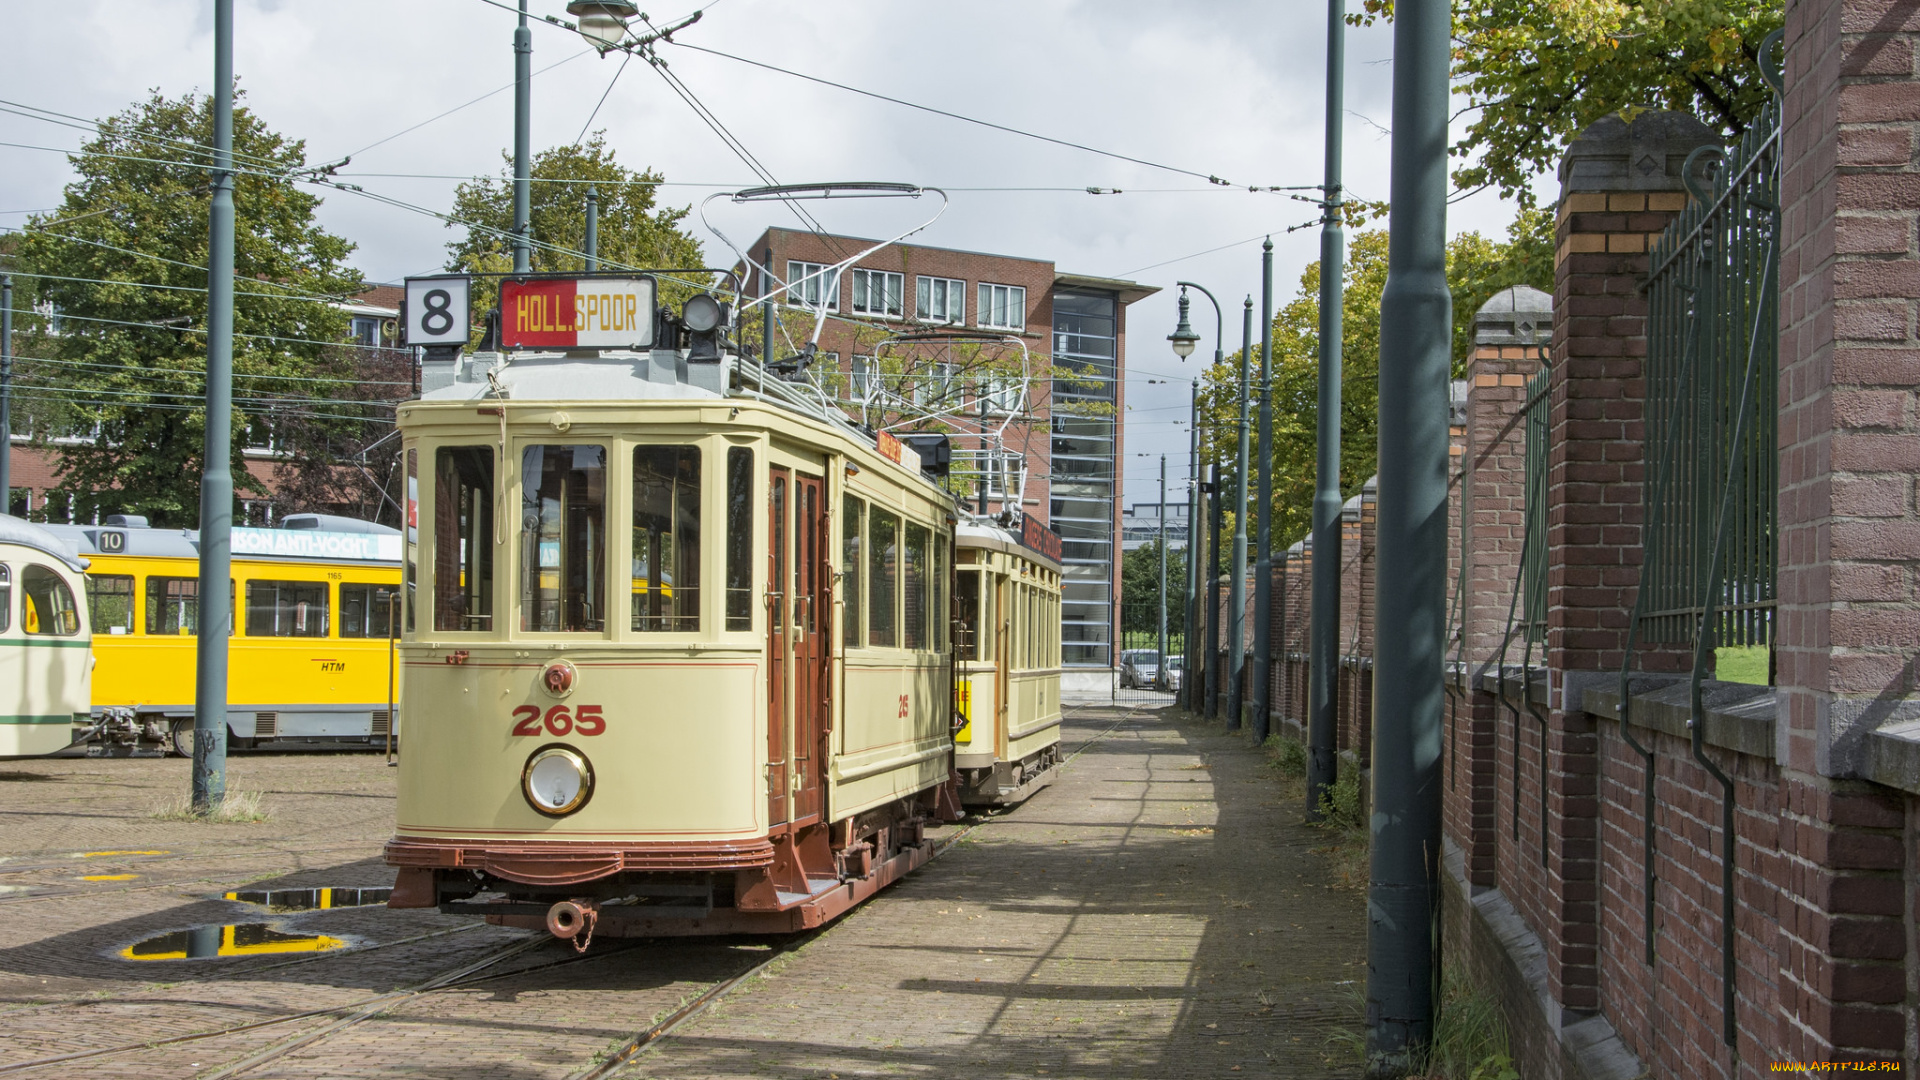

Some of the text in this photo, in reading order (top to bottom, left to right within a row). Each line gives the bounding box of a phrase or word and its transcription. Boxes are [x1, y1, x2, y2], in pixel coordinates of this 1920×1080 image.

[421, 289, 454, 336] 8
[101, 532, 122, 549] 10
[275, 533, 368, 555] ANTI-VOCHT
[327, 572, 342, 580] 1165
[321, 662, 345, 672] HTM
[898, 694, 909, 719] 265
[511, 704, 607, 737] 265
